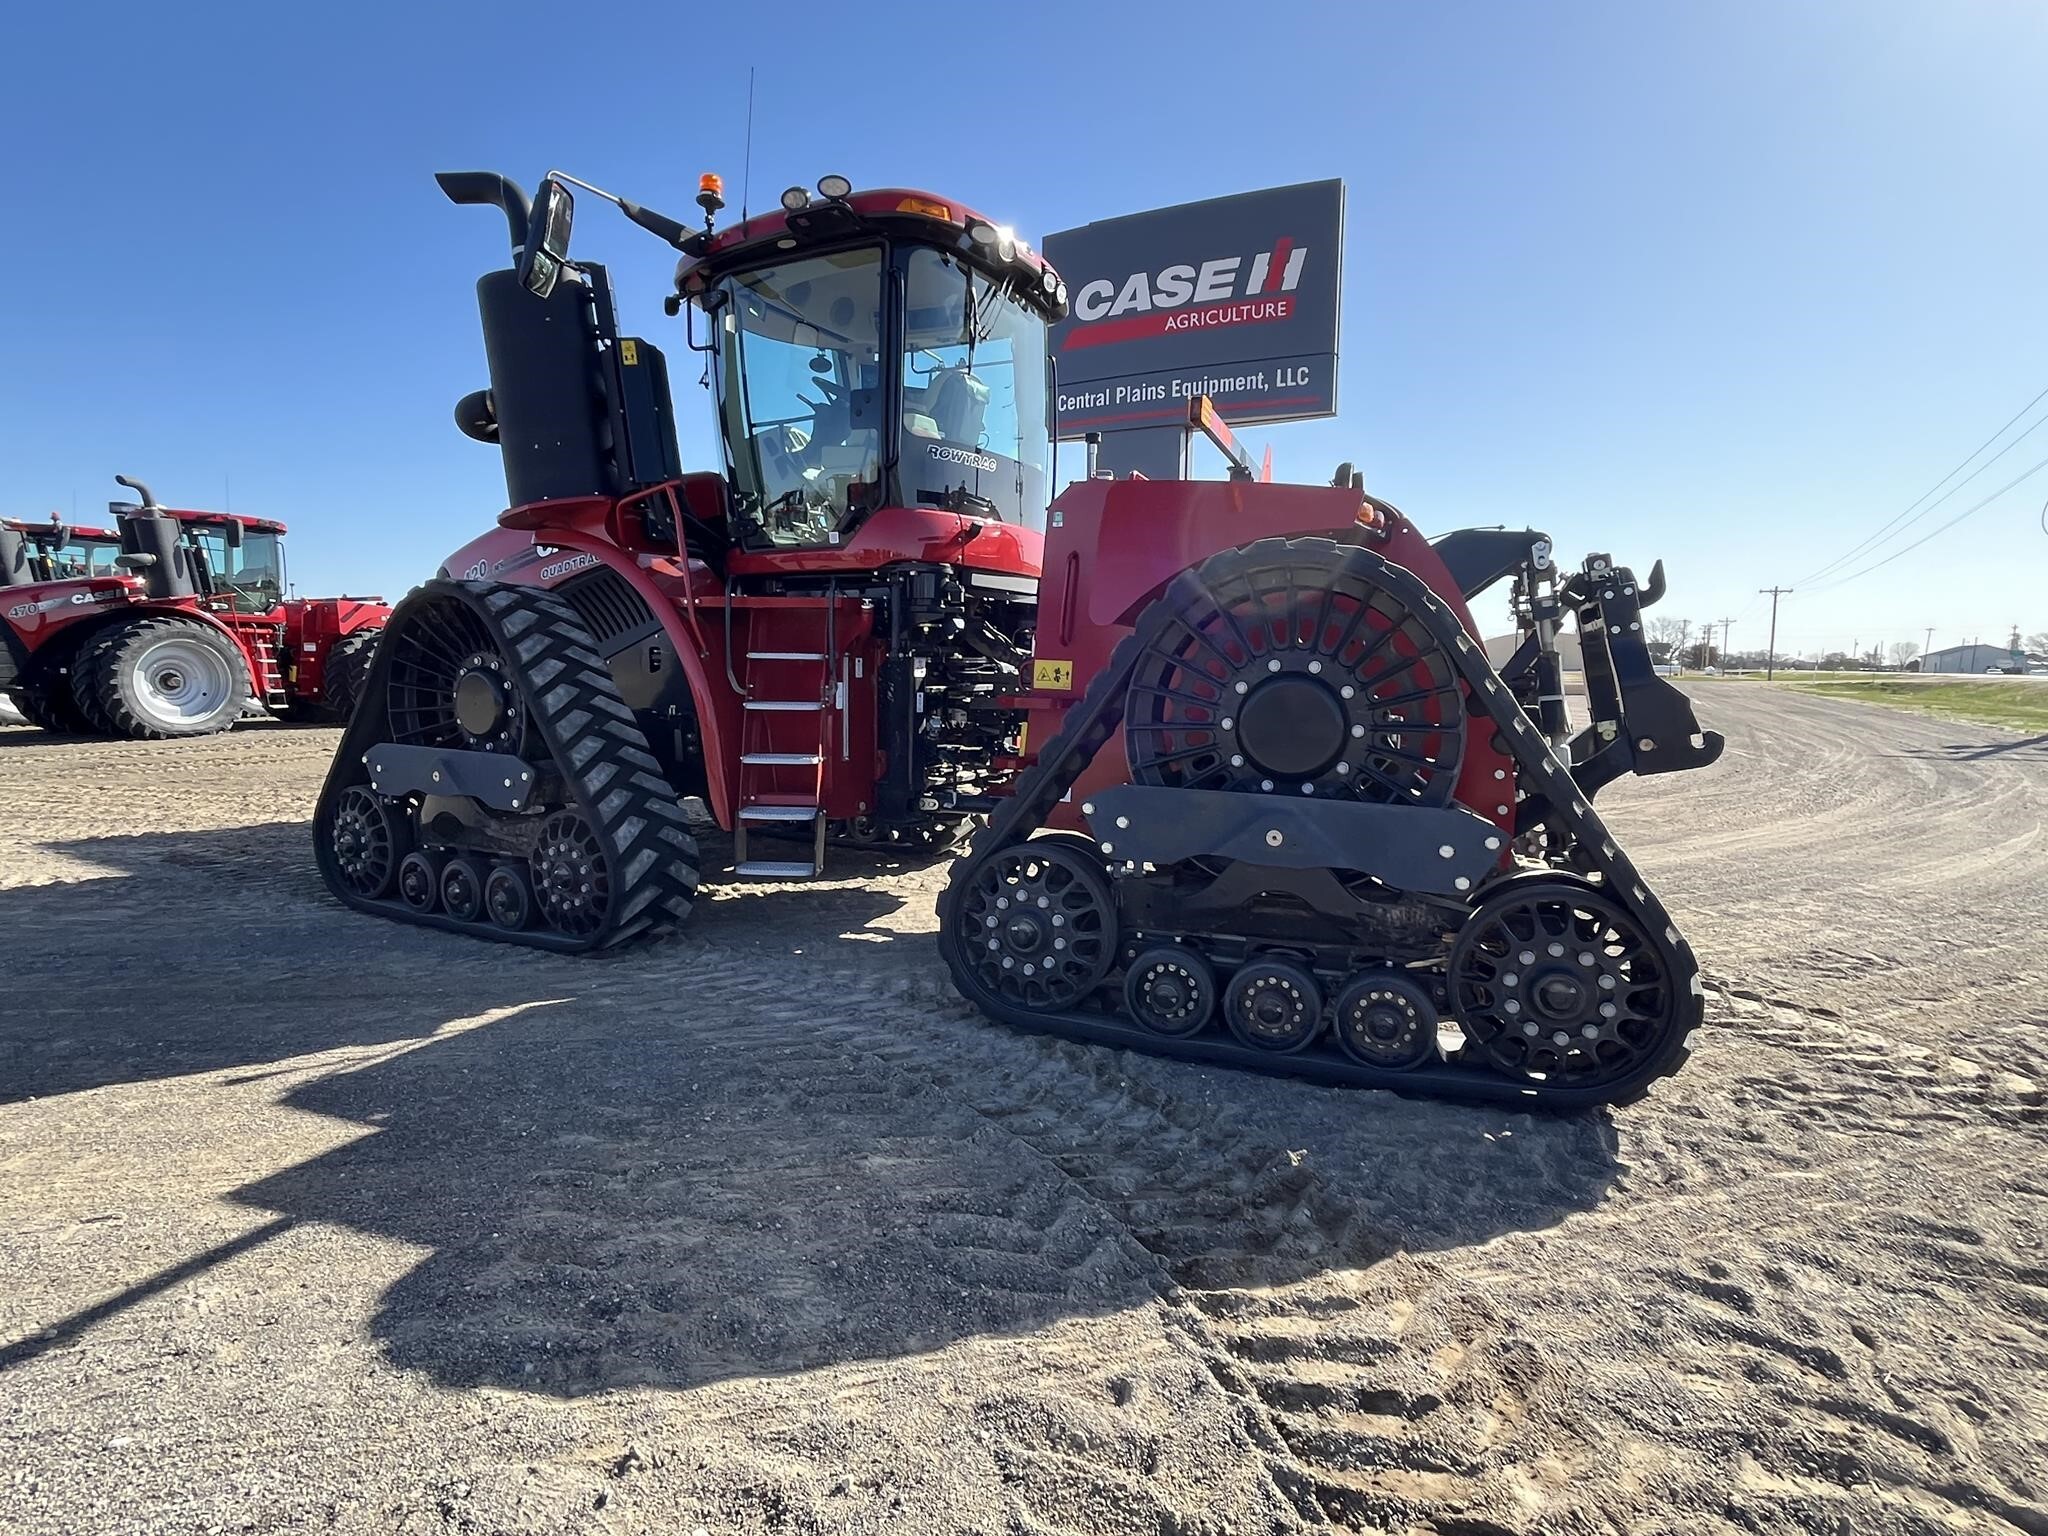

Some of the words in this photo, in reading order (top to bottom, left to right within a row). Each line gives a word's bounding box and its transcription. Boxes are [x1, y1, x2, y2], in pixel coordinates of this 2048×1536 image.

[1075, 257, 1241, 321] CASE
[1165, 301, 1287, 331] AGRICULTURE
[1058, 388, 1110, 412] Central
[1116, 383, 1166, 404] Plains
[1171, 371, 1269, 400] Equipment,
[1276, 366, 1309, 388] LLC
[926, 444, 997, 472] ROWTRAC
[8, 602, 39, 618] 470
